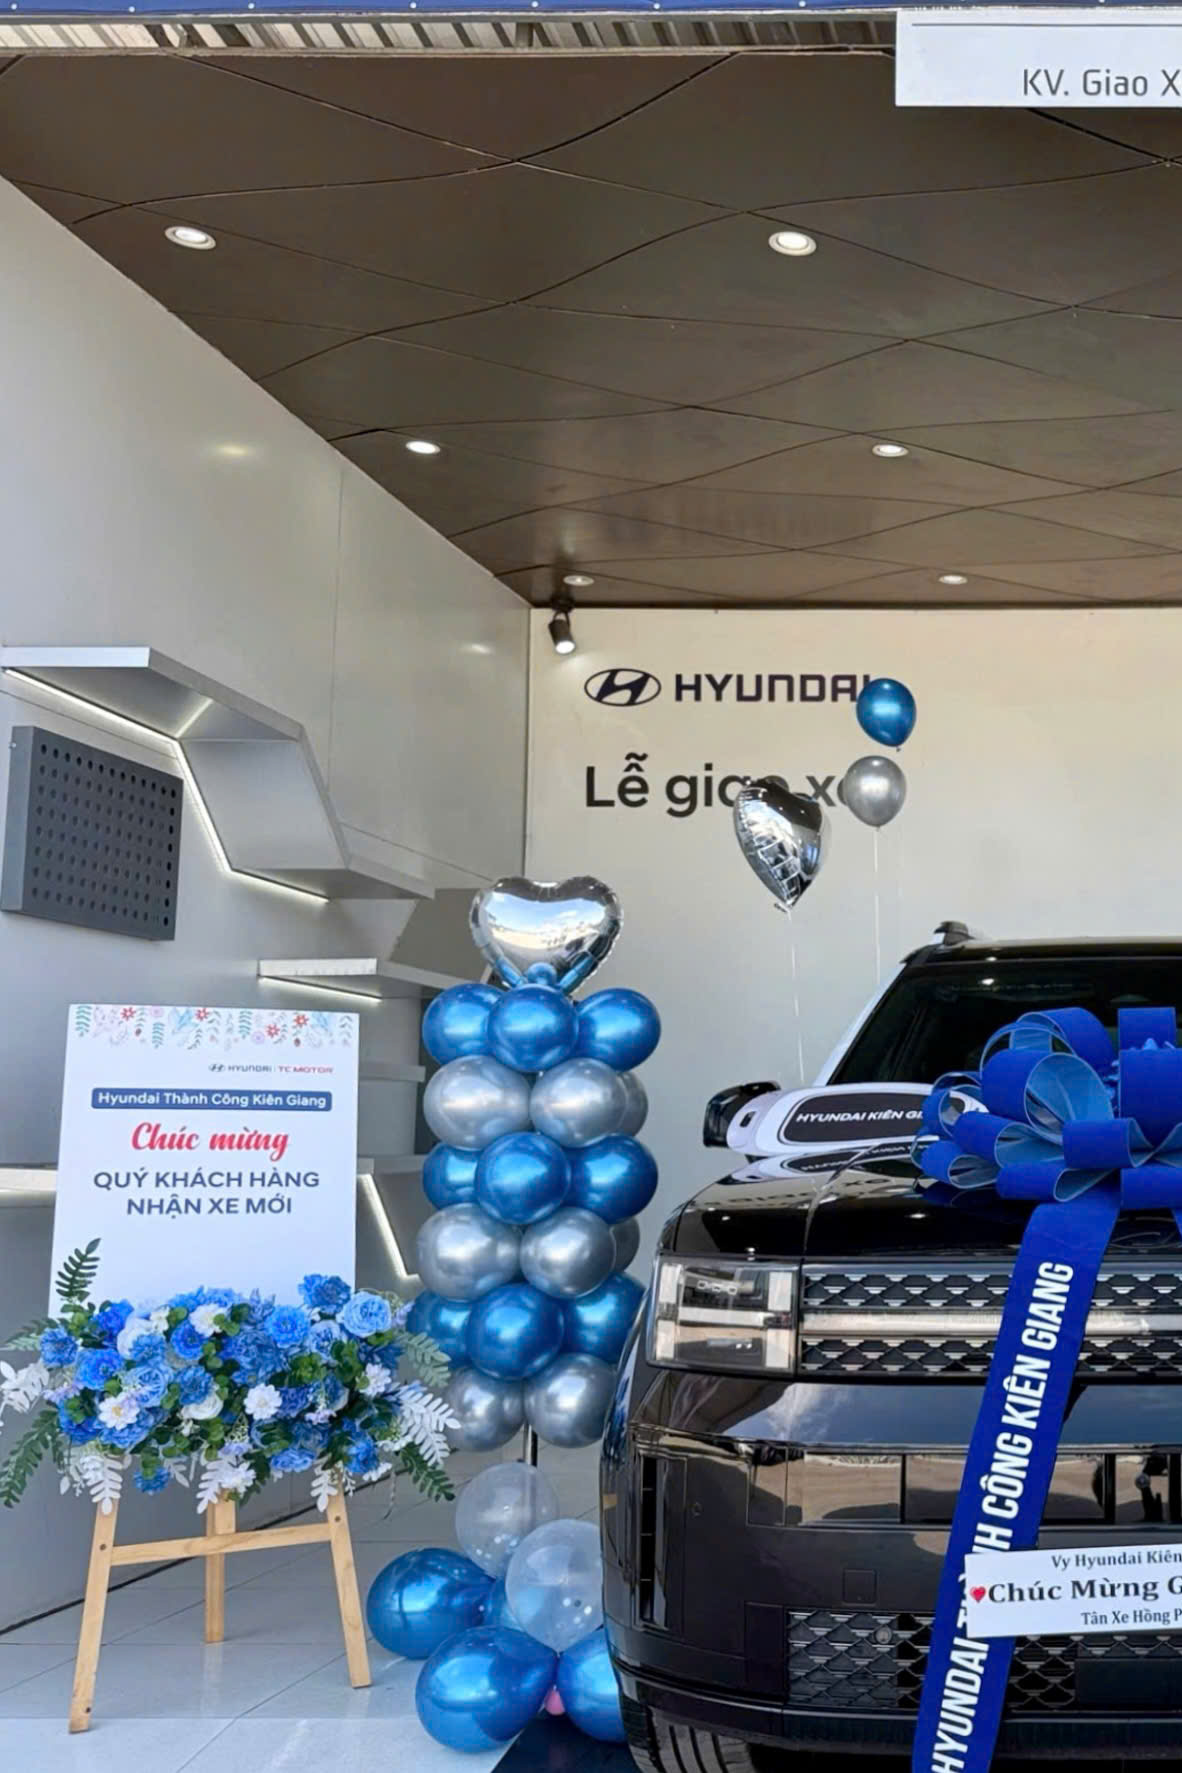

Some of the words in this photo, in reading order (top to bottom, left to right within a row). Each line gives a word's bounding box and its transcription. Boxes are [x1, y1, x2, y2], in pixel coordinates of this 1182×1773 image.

[1022, 69, 1069, 97] KV.
[1082, 69, 1148, 97] Giao
[586, 752, 650, 808] Lễ
[806, 775, 850, 807] x
[98, 1092, 160, 1106] Hyundai
[164, 1091, 208, 1105] Thành
[212, 1090, 249, 1107] Công
[252, 1091, 283, 1106] Kiên
[286, 1093, 327, 1109] Giang
[796, 1111, 866, 1122] HYUNDAI
[868, 1109, 904, 1120] KIÊN
[131, 1121, 200, 1151] Chúc
[209, 1126, 290, 1162] mừng
[93, 1167, 149, 1189] QUÝ
[154, 1166, 243, 1188] KHÁCH
[250, 1166, 321, 1188] HÀNG
[126, 1192, 202, 1219] NHẬN
[207, 1198, 239, 1215] XE
[245, 1191, 292, 1215] MỚI
[1022, 1261, 1074, 1351] GIANG
[1001, 1354, 1052, 1430] KIÊN
[979, 1431, 1034, 1520] CÔNG
[1051, 1553, 1071, 1571] Vy
[1075, 1551, 1142, 1570] Hyundai
[1146, 1548, 1182, 1564] Kiên
[988, 1577, 1062, 1604] Chúc
[1071, 1576, 1159, 1602] Mừng
[1081, 1610, 1108, 1626] Tân
[1112, 1610, 1130, 1625] Xe
[1132, 1607, 1171, 1625] Hồng
[931, 1636, 990, 1773] HYUNDAI
